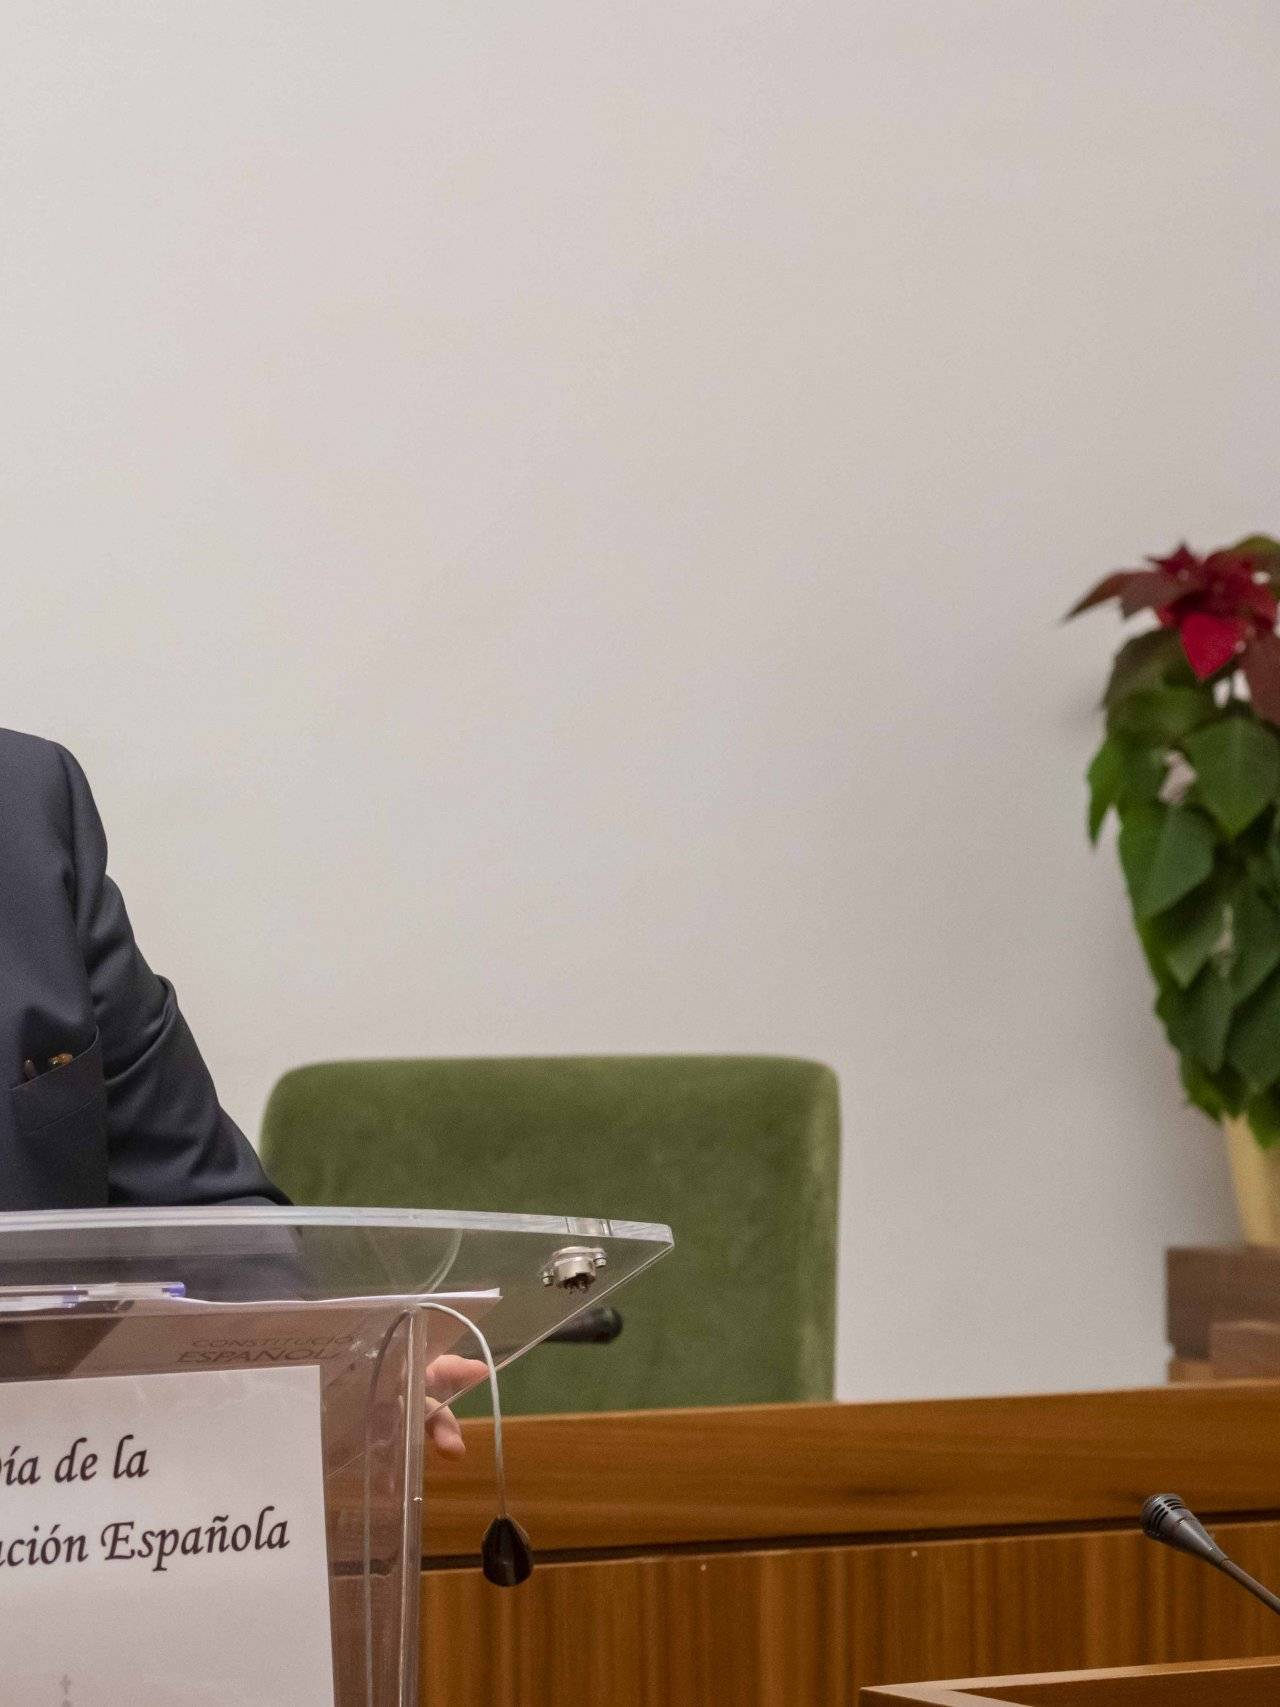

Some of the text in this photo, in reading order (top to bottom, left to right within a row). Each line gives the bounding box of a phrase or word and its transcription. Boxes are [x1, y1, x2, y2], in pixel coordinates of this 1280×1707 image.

[54, 1436, 98, 1484] de
[112, 1433, 150, 1480] la
[100, 1505, 290, 1572] Española
